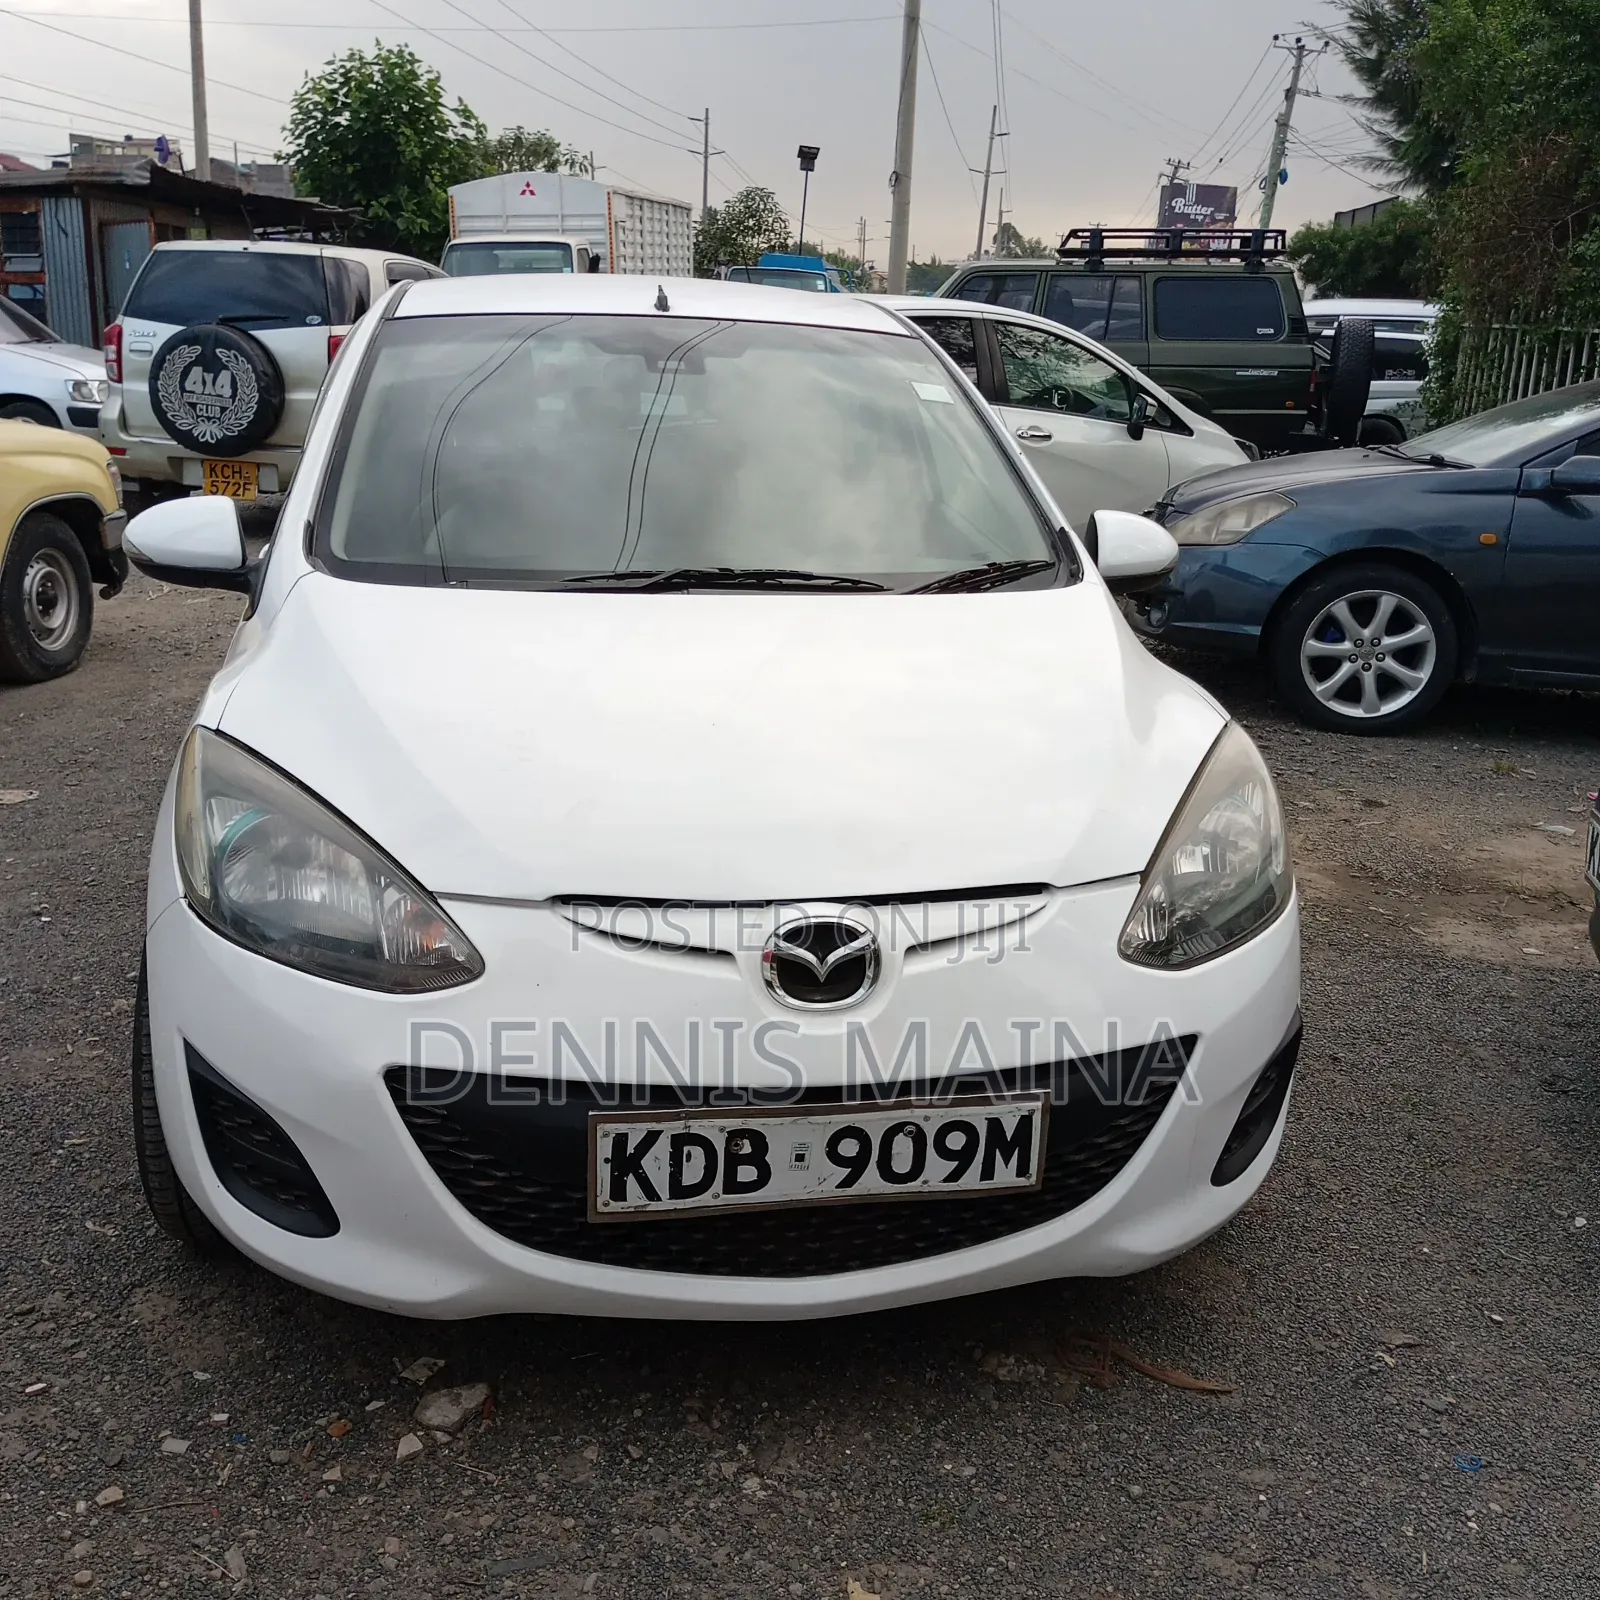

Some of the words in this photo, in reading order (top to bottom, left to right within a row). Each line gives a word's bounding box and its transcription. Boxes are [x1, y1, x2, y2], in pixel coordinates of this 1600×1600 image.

[1171, 198, 1214, 215] Butter
[185, 366, 232, 398] 4x4
[196, 404, 220, 418] CLUB
[209, 463, 242, 480] KCH
[209, 480, 253, 497] 572F
[1588, 825, 1600, 880] K
[608, 1128, 772, 1202] KDB
[825, 1114, 1034, 1189] 909M
